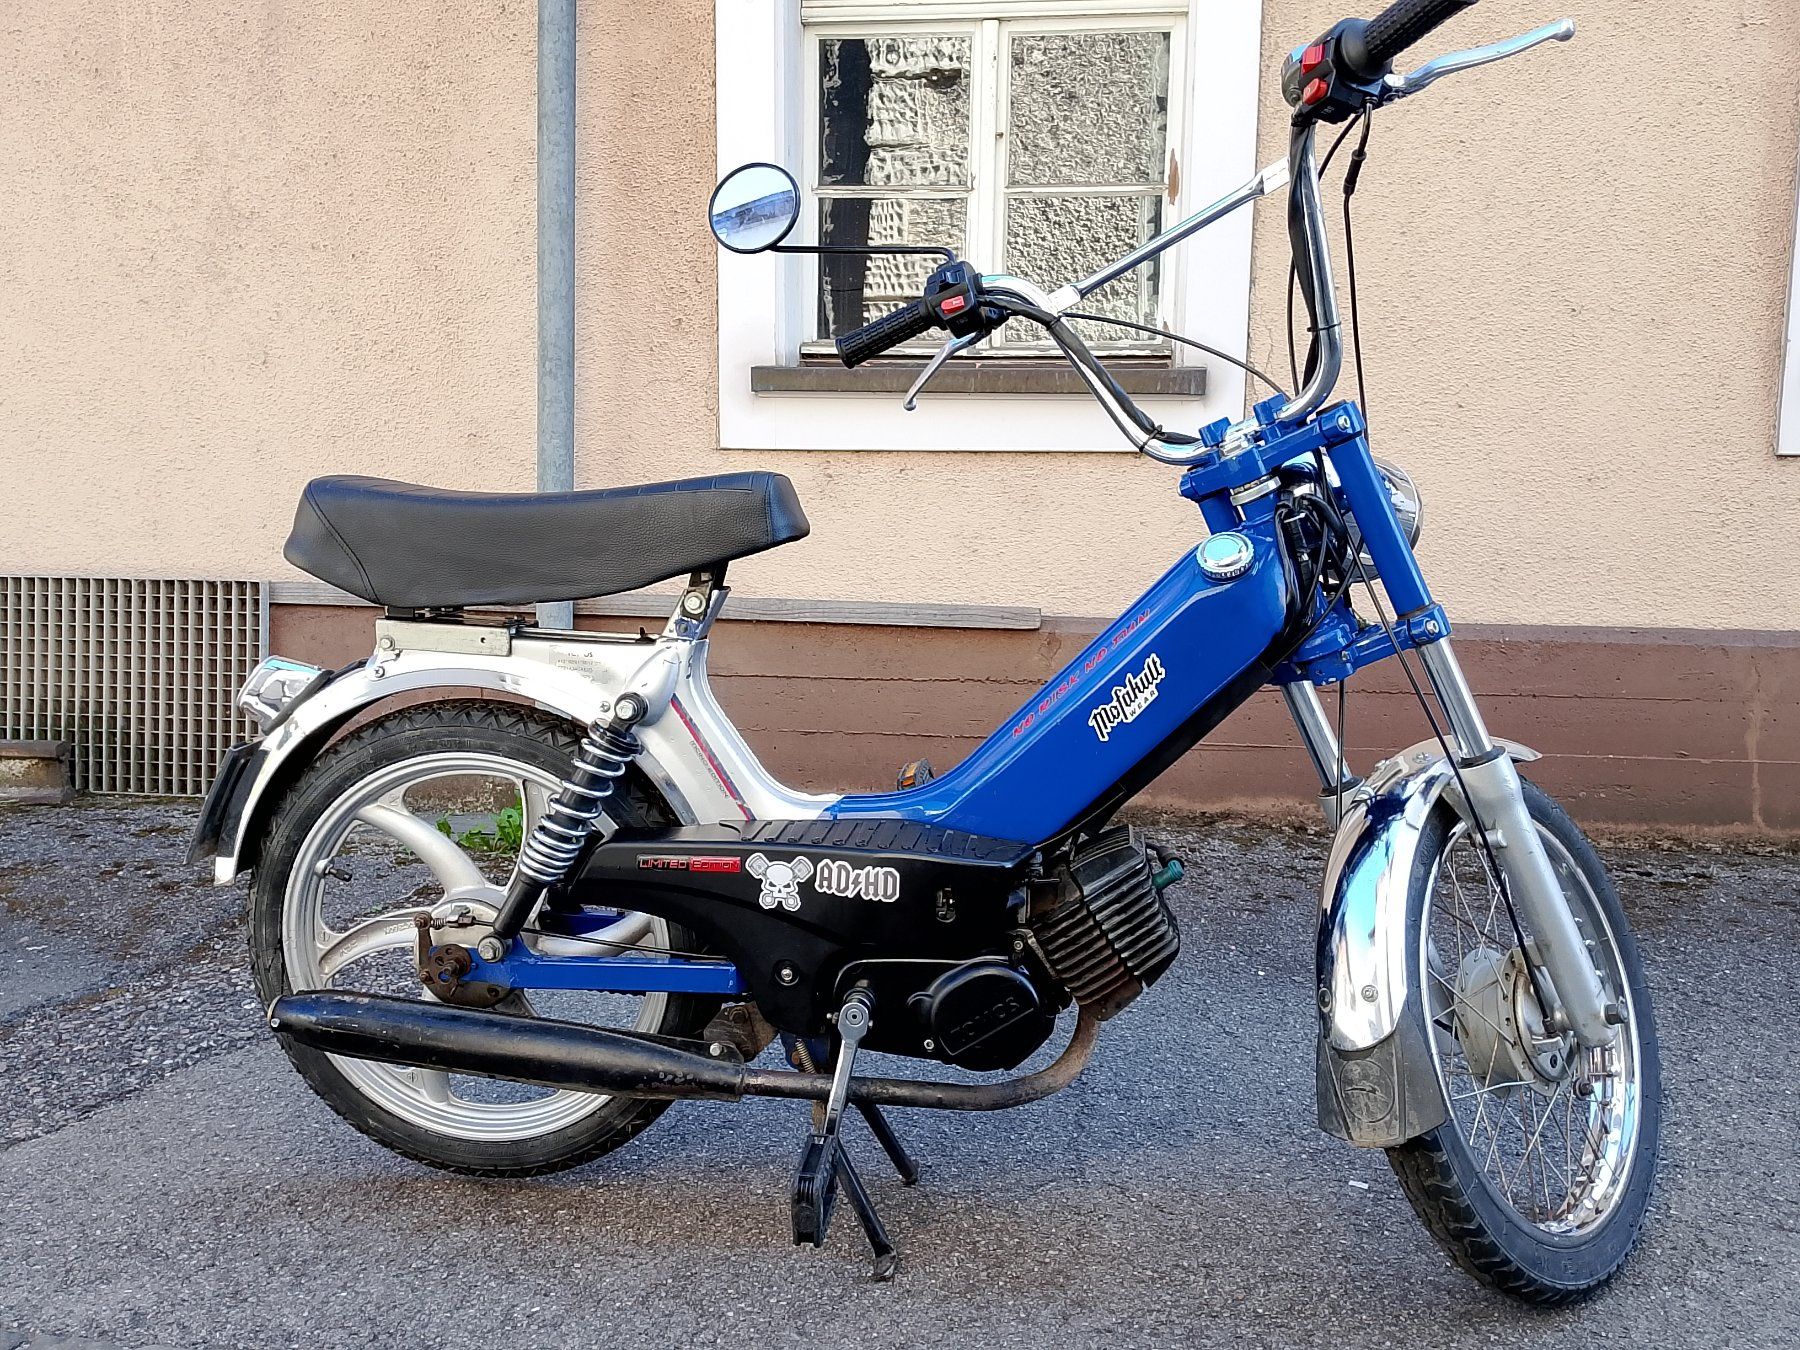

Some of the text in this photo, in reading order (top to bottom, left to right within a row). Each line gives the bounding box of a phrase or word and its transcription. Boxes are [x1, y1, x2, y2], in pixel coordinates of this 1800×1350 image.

[1014, 713, 1034, 737] NO
[1039, 672, 1079, 715] RISK
[1084, 648, 1107, 673] NO
[1092, 657, 1162, 738] Mofakult
[1129, 690, 1156, 717] WEAR
[639, 858, 741, 871] LIMITED EDITION
